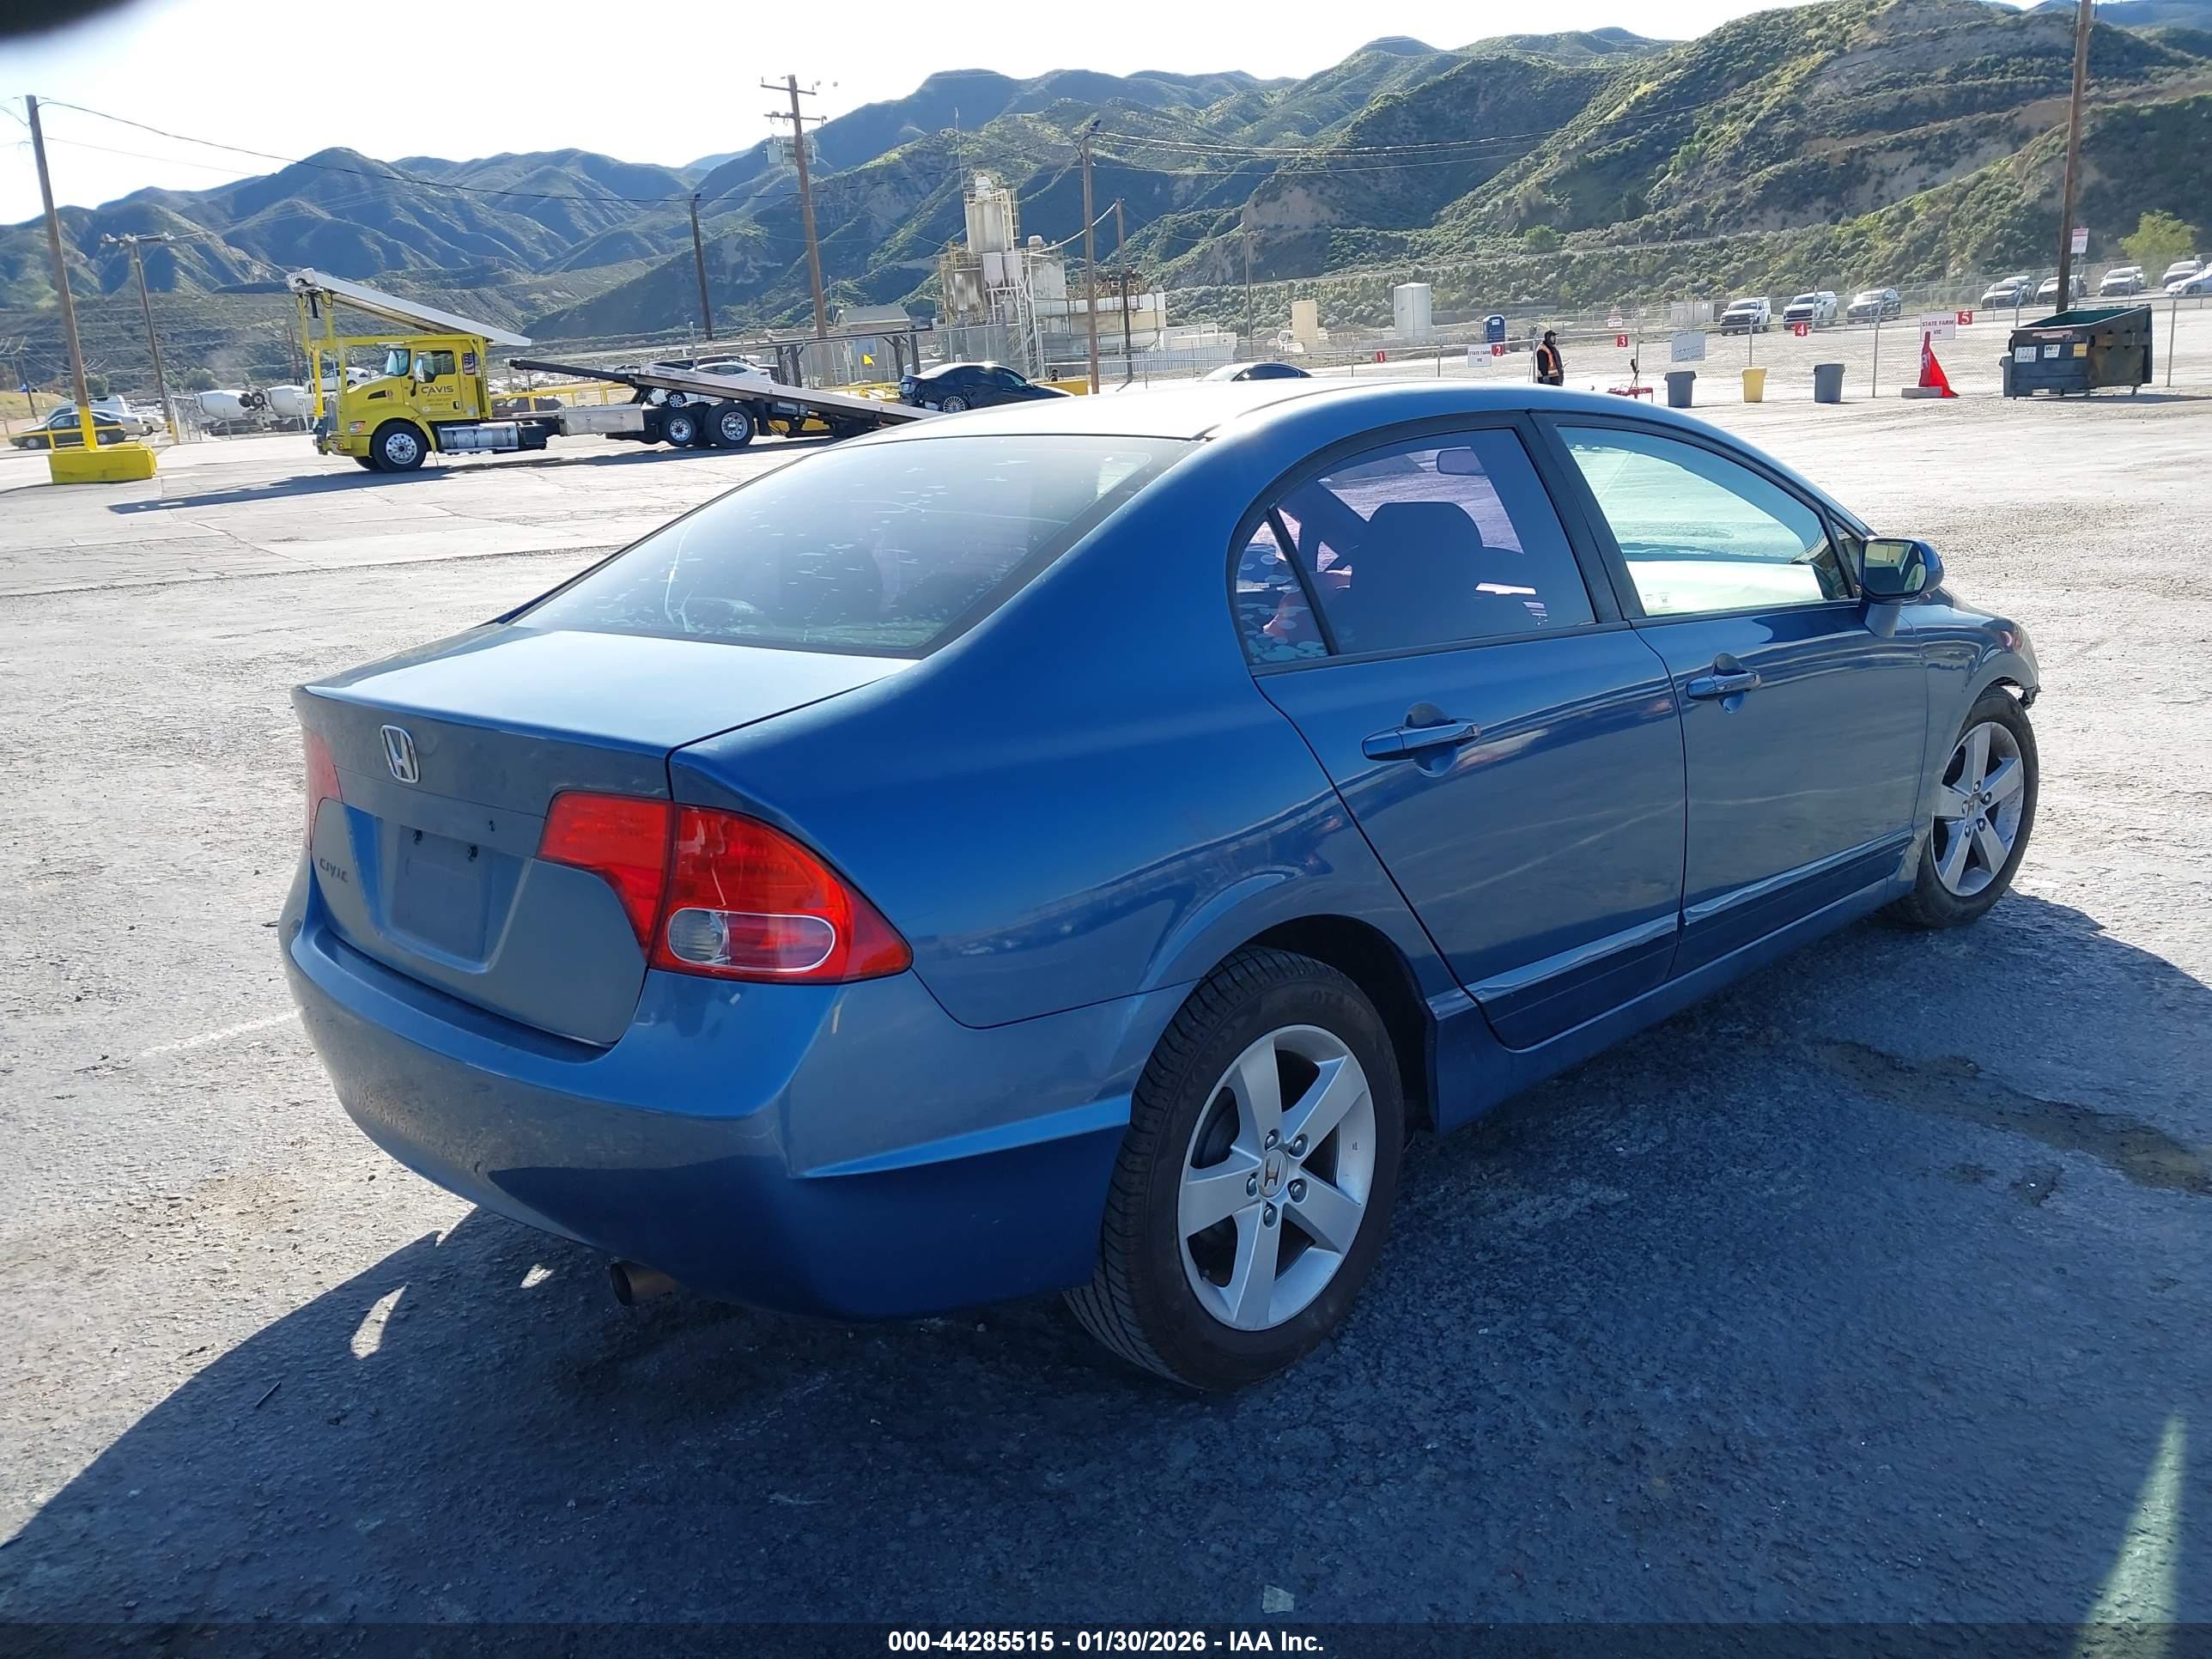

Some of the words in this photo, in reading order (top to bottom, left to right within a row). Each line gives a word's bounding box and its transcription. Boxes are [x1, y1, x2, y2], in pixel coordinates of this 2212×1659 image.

[1961, 312, 1970, 325] 5
[1796, 323, 1805, 336] 4
[1619, 336, 1626, 347] 3
[1496, 345, 1502, 356] 2
[421, 385, 454, 398] CAVIS
[319, 858, 349, 884] CIVIC
